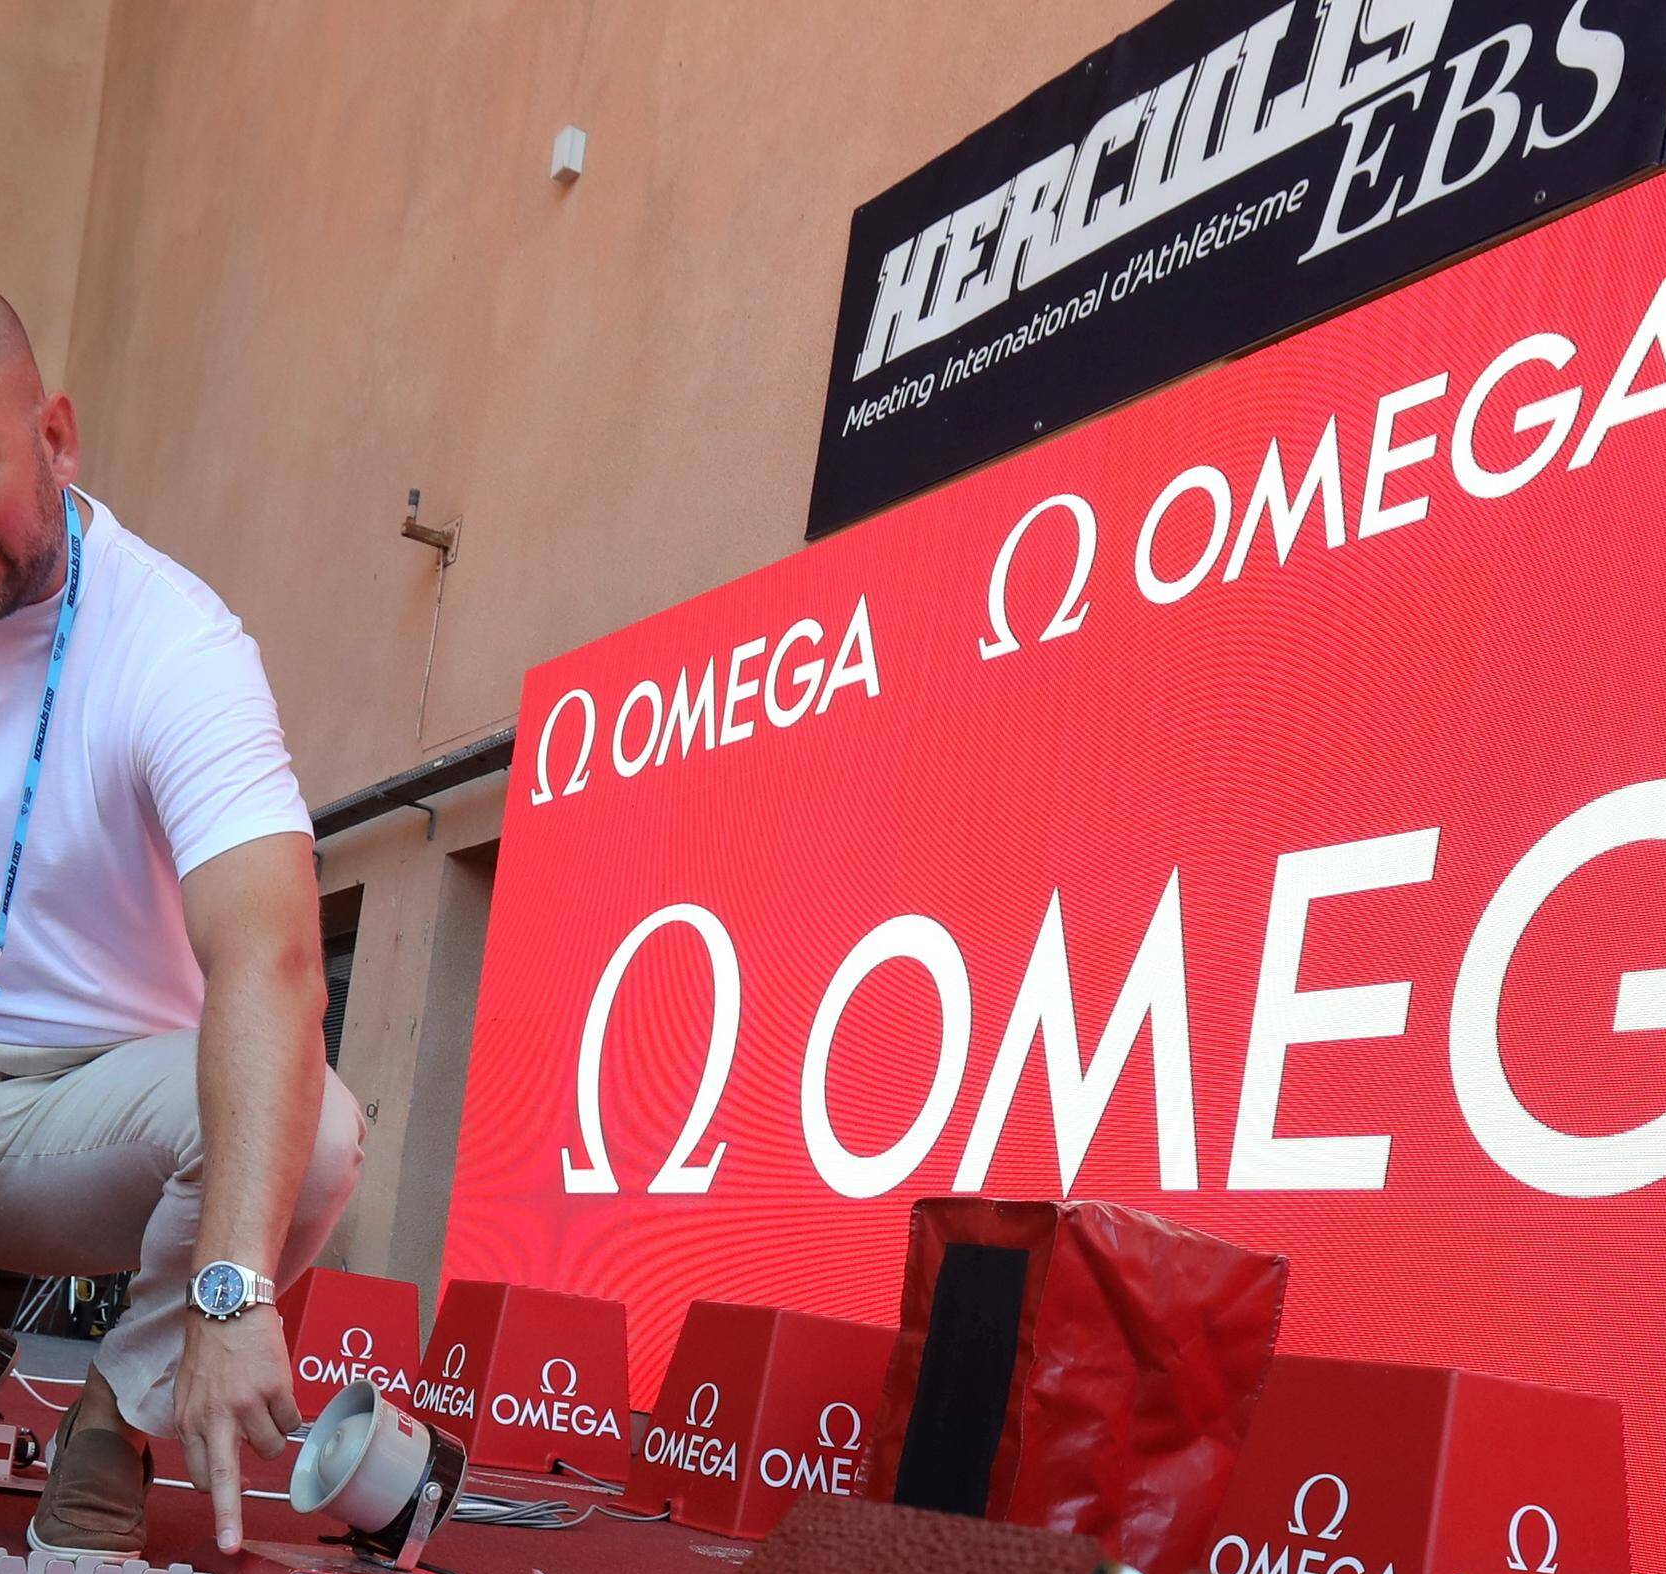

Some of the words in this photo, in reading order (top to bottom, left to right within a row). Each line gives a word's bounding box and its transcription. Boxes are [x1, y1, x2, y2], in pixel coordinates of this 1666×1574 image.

[1297, 0, 1625, 265] EBS
[843, 370, 933, 437] Meeting
[940, 272, 1107, 392] International
[1110, 178, 1309, 302] d'Athlétisme
[613, 594, 880, 777] OMEGA
[299, 1355, 411, 1395] OMEGA
[413, 1379, 475, 1420] OMEGA
[492, 1393, 621, 1440] OMEGA
[644, 1426, 737, 1482] OMEGA
[760, 1447, 861, 1497] OME
